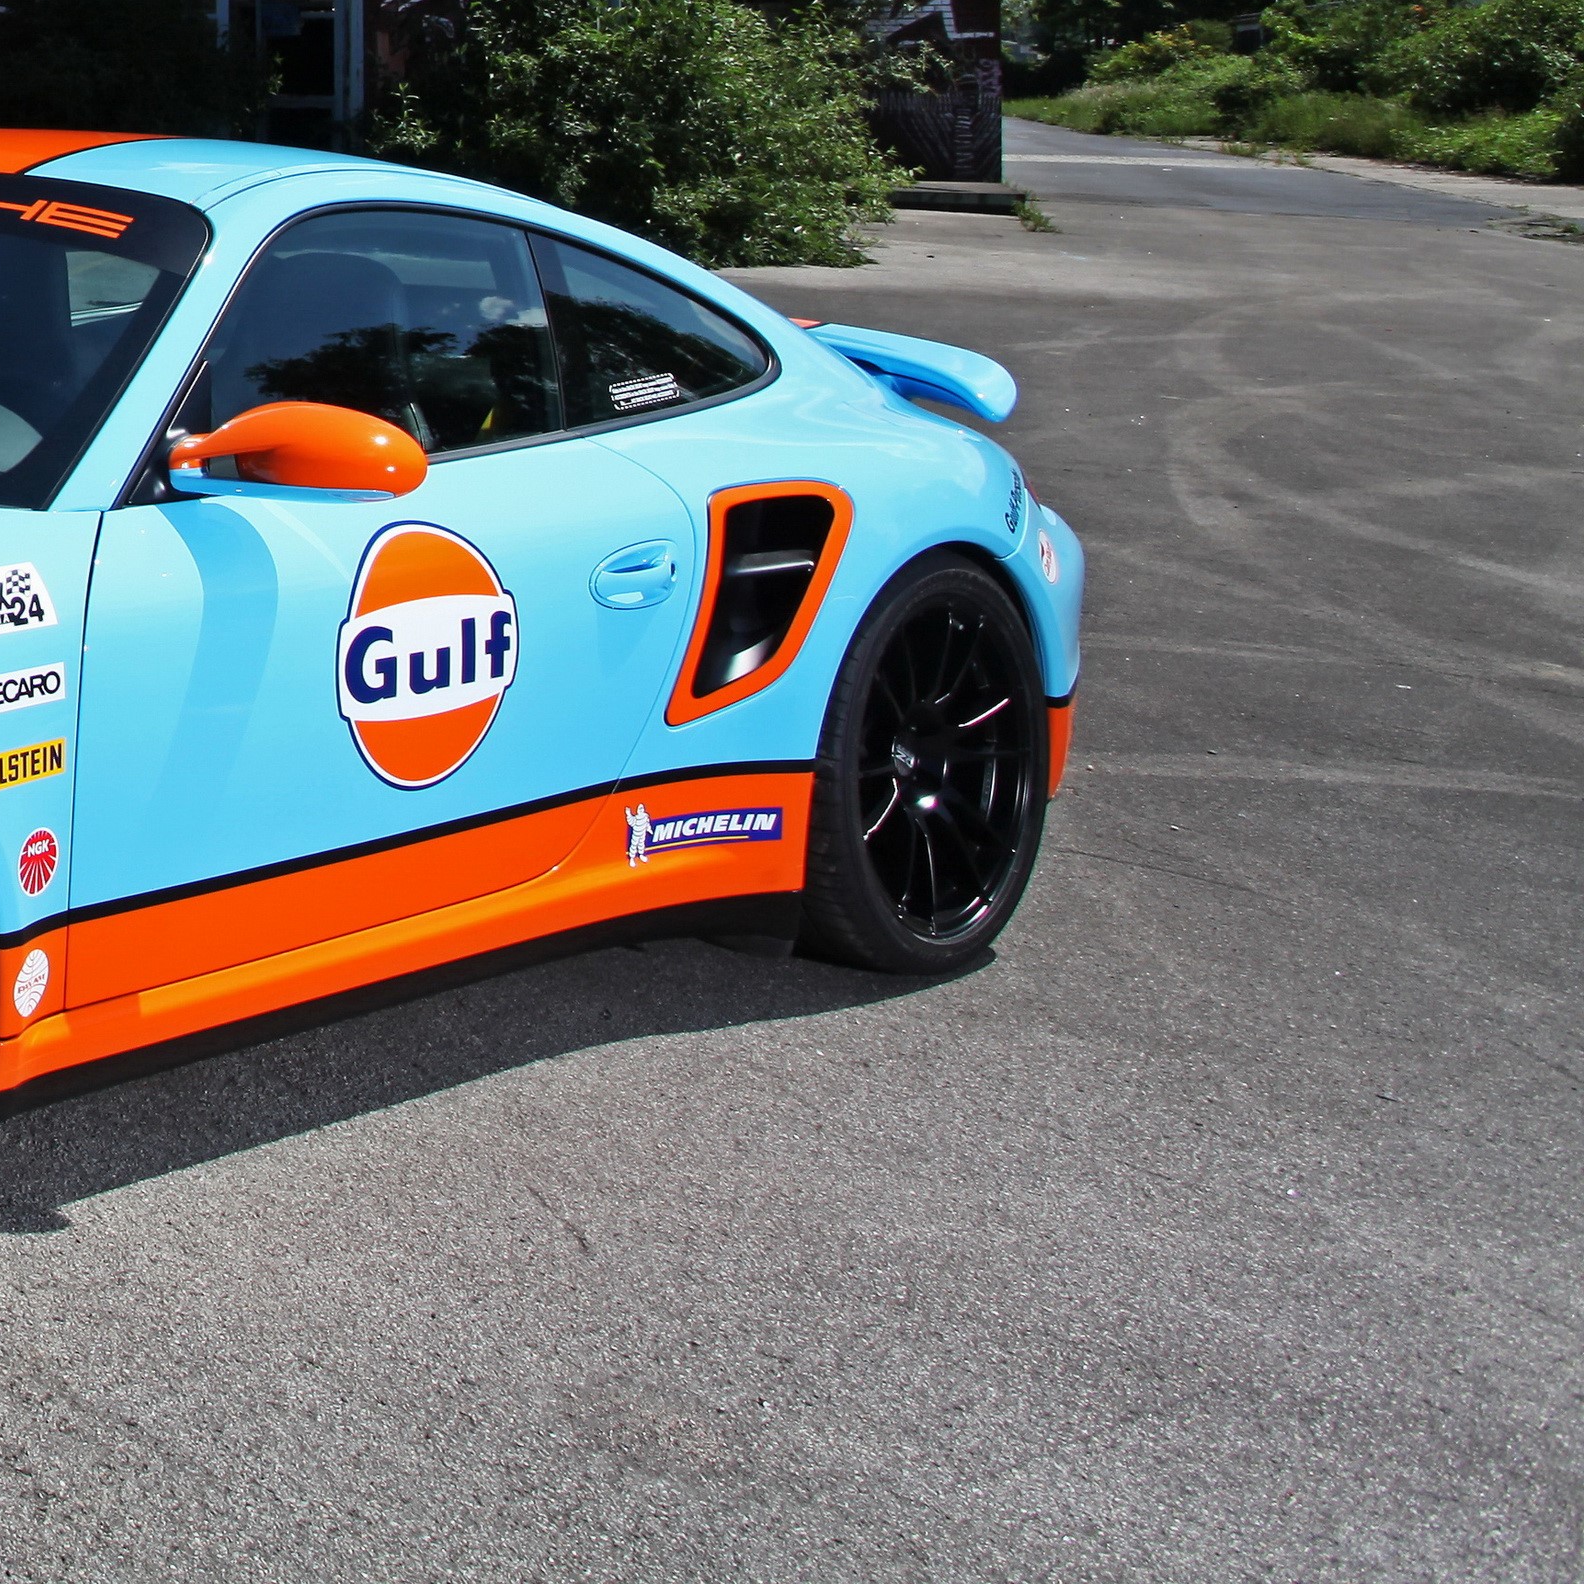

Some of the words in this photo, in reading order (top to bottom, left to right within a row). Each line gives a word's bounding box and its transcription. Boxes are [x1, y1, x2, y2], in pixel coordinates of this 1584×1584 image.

[10, 594, 44, 626] 24
[345, 611, 511, 704] Gulf
[652, 813, 777, 843] MICHELIN
[27, 839, 50, 858] NGK
